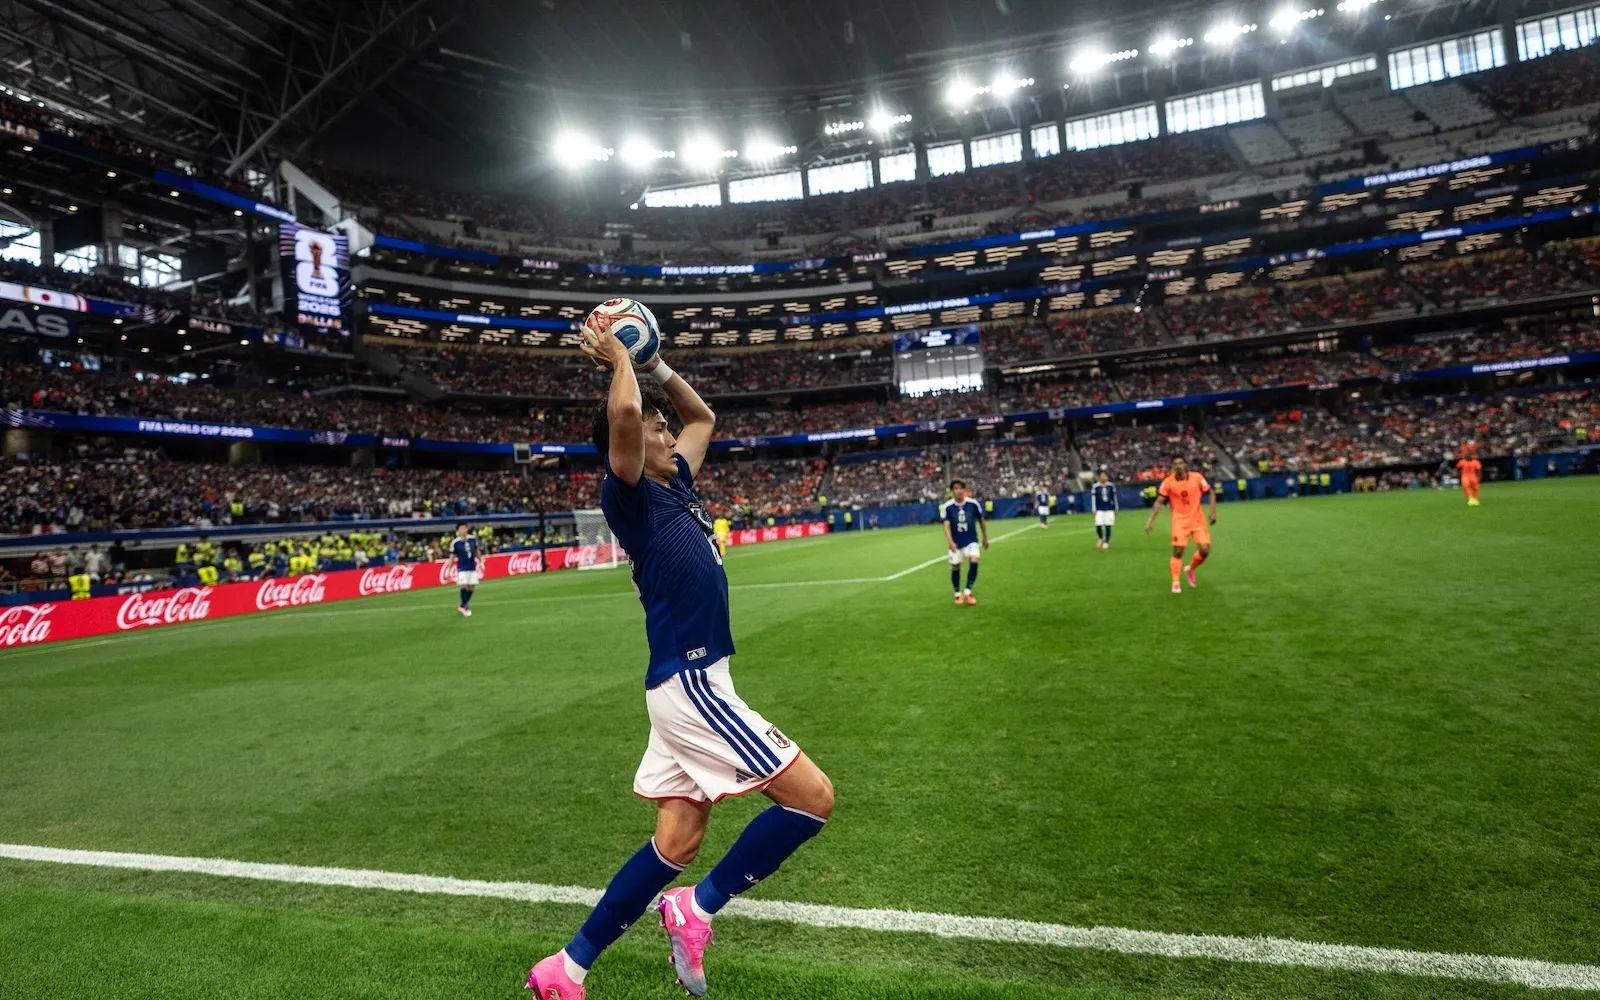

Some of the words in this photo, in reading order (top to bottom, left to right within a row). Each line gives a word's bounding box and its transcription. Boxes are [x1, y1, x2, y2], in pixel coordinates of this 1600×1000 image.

[1364, 173, 1387, 187] FIFA
[1388, 167, 1426, 181] WORLD
[1428, 162, 1449, 175] CUP
[1450, 155, 1492, 172] 2026
[661, 266, 679, 275] FIFA
[680, 266, 708, 275] WORLD
[709, 266, 725, 274] CUP
[726, 264, 755, 274] 2026
[139, 420, 163, 431] FIFA
[163, 422, 200, 434] WORLD
[201, 425, 220, 435] CUP
[220, 426, 254, 438] 2026
